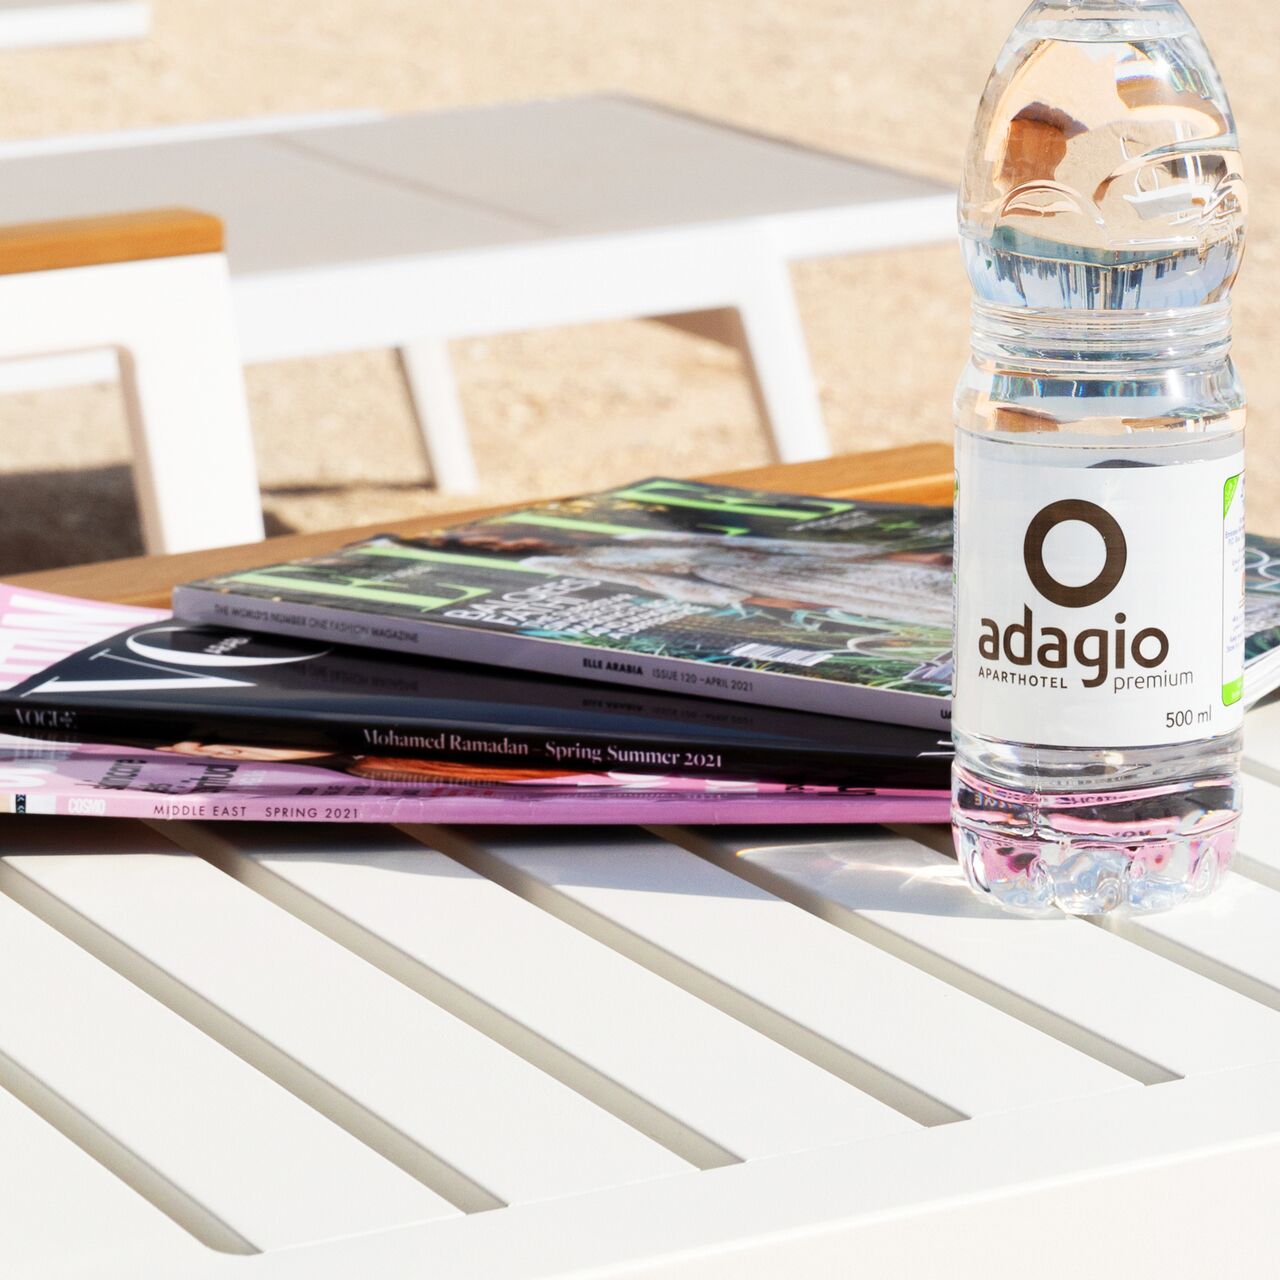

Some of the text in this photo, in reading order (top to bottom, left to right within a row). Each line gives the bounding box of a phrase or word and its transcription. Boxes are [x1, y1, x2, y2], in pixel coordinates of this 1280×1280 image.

[214, 603, 229, 617] THE
[270, 612, 307, 627] NUMBER
[309, 617, 328, 630] ONE
[329, 621, 369, 636] FASHION
[371, 626, 420, 643] MAGAZINE
[978, 603, 1169, 689] adagio
[582, 657, 603, 670] ELLE
[605, 662, 643, 676] ARABIA
[652, 668, 678, 681] ISSUE
[680, 672, 697, 684] 120
[730, 680, 753, 692] 2021
[978, 666, 1068, 689] APARTHOTEL
[1113, 670, 1194, 694] premium
[1165, 705, 1212, 728] 500 ml
[363, 728, 445, 750] Mohamed
[450, 734, 529, 755] Ramadan
[545, 741, 601, 762] Spring
[607, 745, 680, 766] Summer
[683, 752, 723, 768] 2021
[68, 797, 106, 815] COSMO
[153, 804, 359, 819] MIDDLE EAST SPRING 2021
